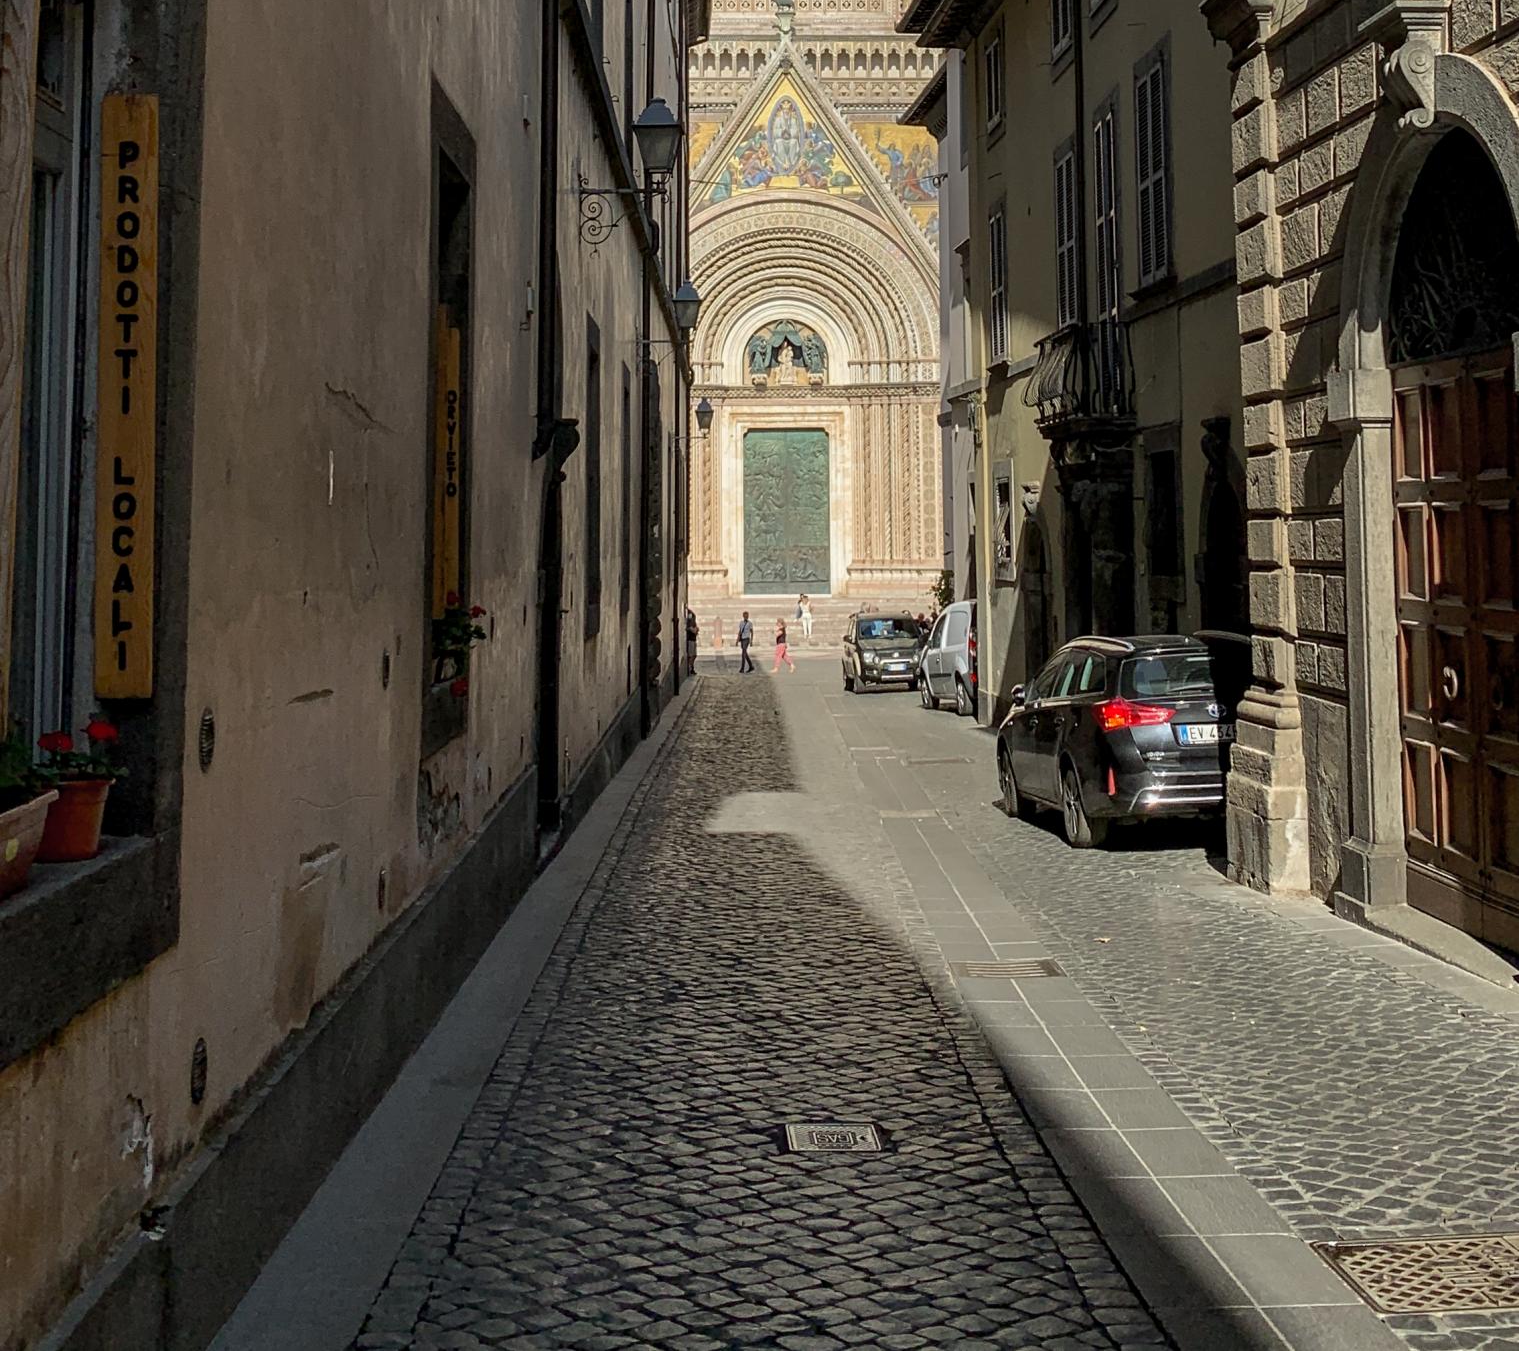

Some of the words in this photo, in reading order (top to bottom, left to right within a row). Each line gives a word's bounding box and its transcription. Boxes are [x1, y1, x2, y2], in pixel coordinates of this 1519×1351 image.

[114, 140, 141, 416] PRODOTTI
[446, 389, 457, 498] ORVIETO
[112, 455, 138, 672] LOCALI
[1189, 726, 1204, 740] EV
[816, 1133, 850, 1143] GAS
